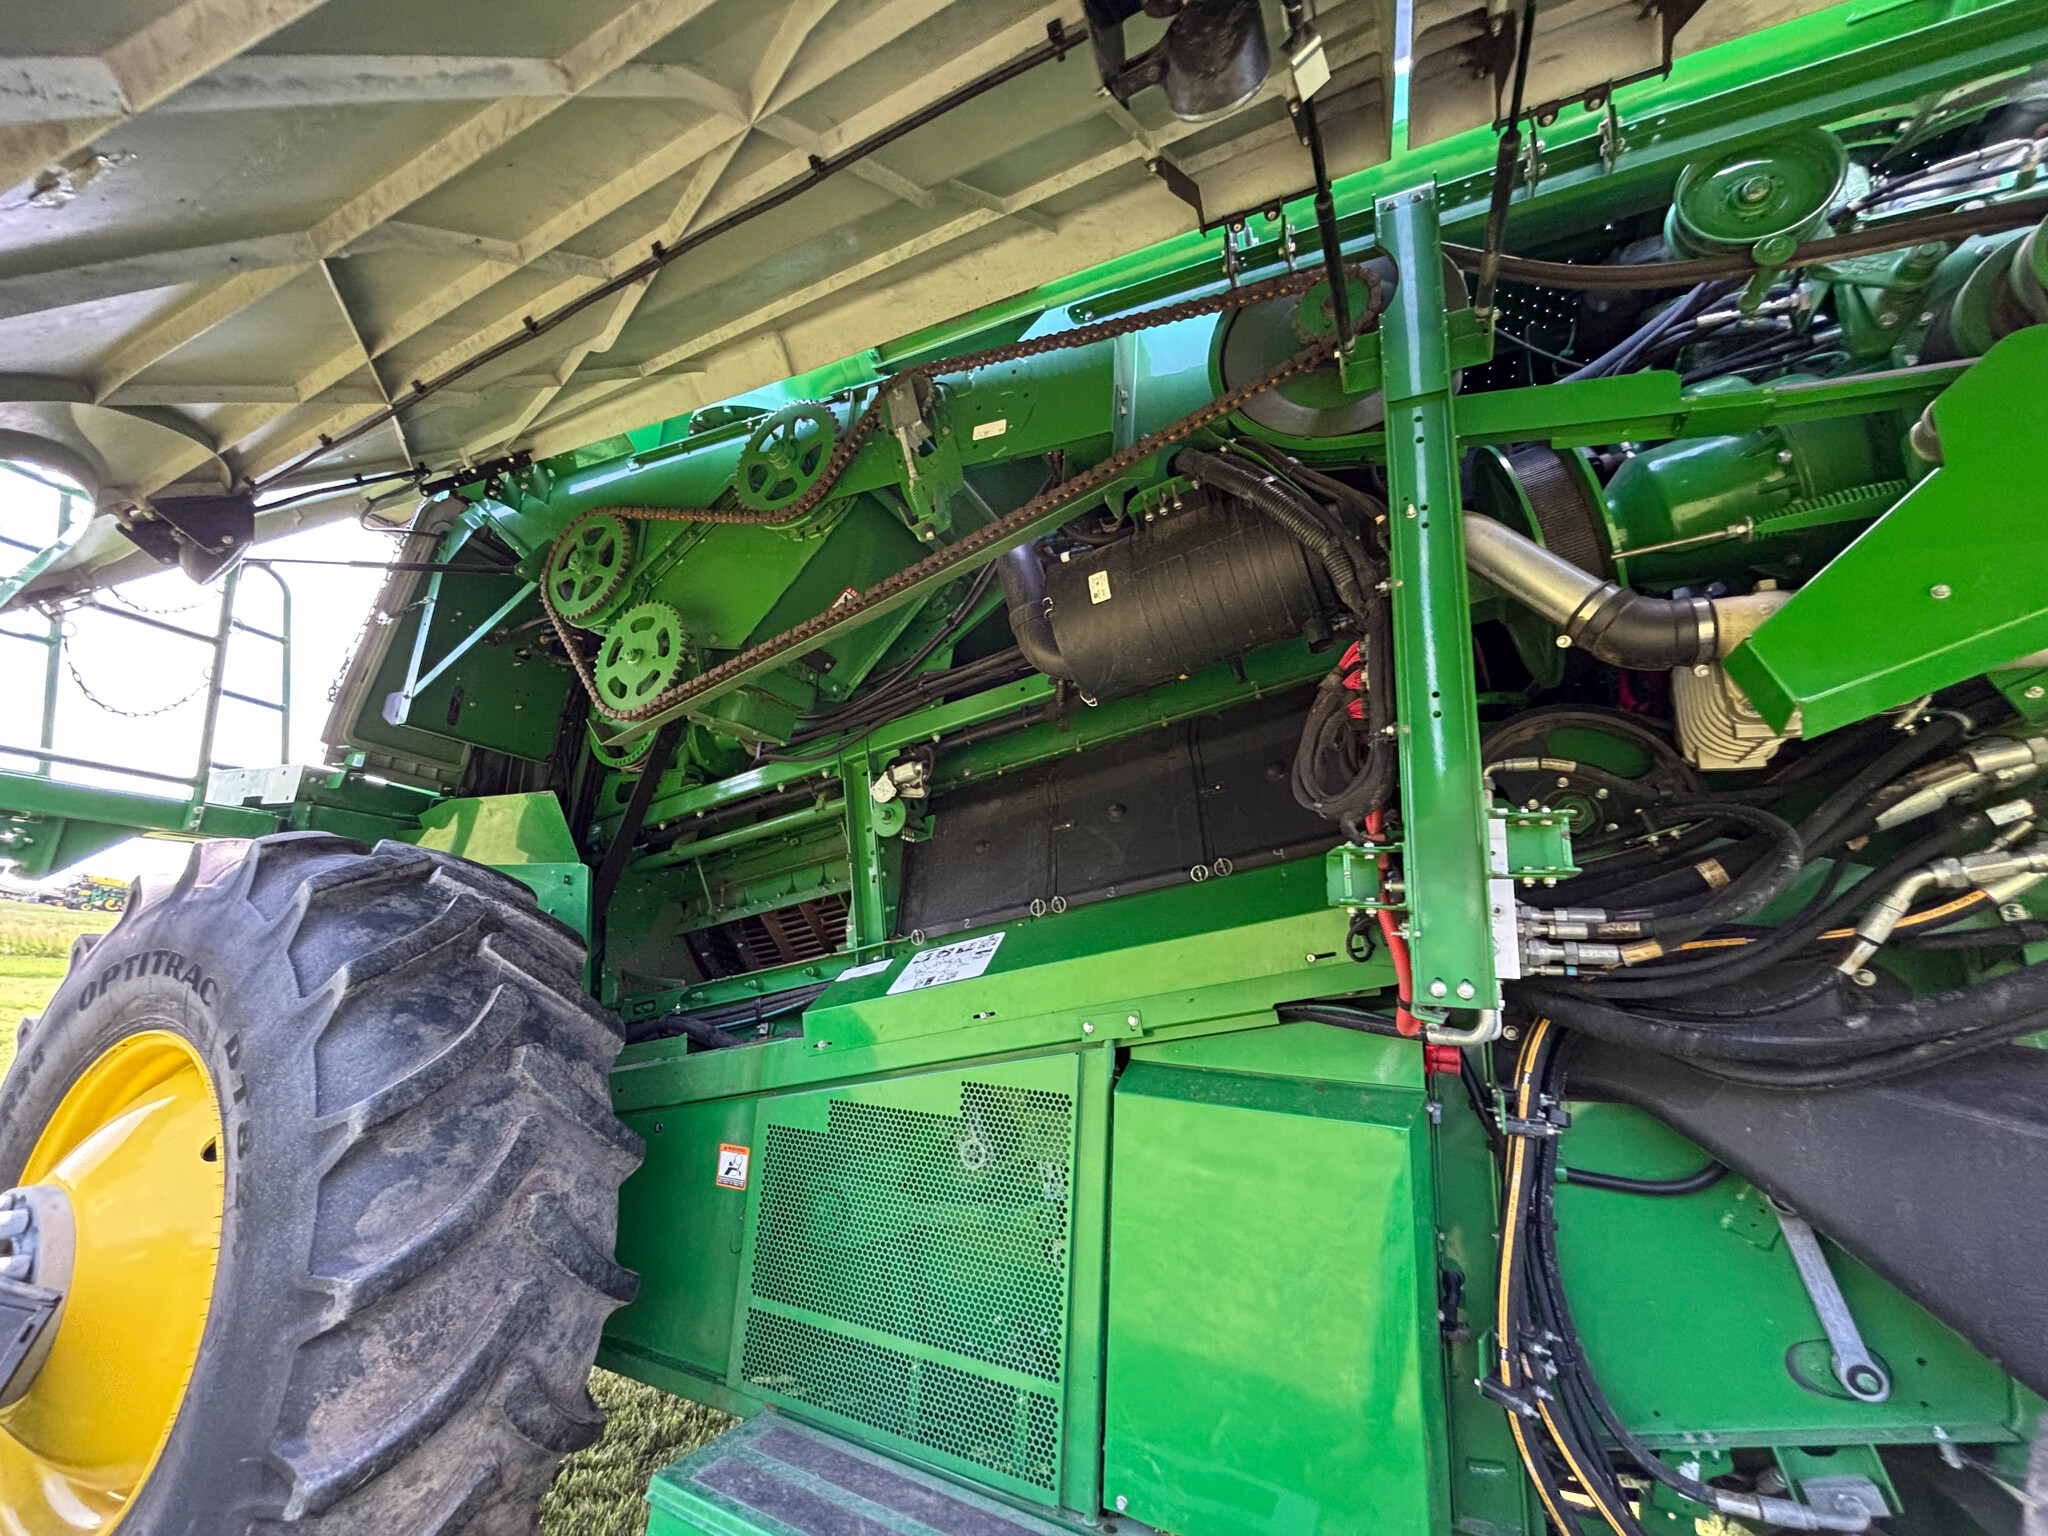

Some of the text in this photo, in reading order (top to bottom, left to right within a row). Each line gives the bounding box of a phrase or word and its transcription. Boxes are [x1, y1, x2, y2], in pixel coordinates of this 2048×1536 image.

[1106, 886, 1116, 898] 3
[963, 918, 972, 929] 2
[78, 948, 219, 1012] OPTITRAC
